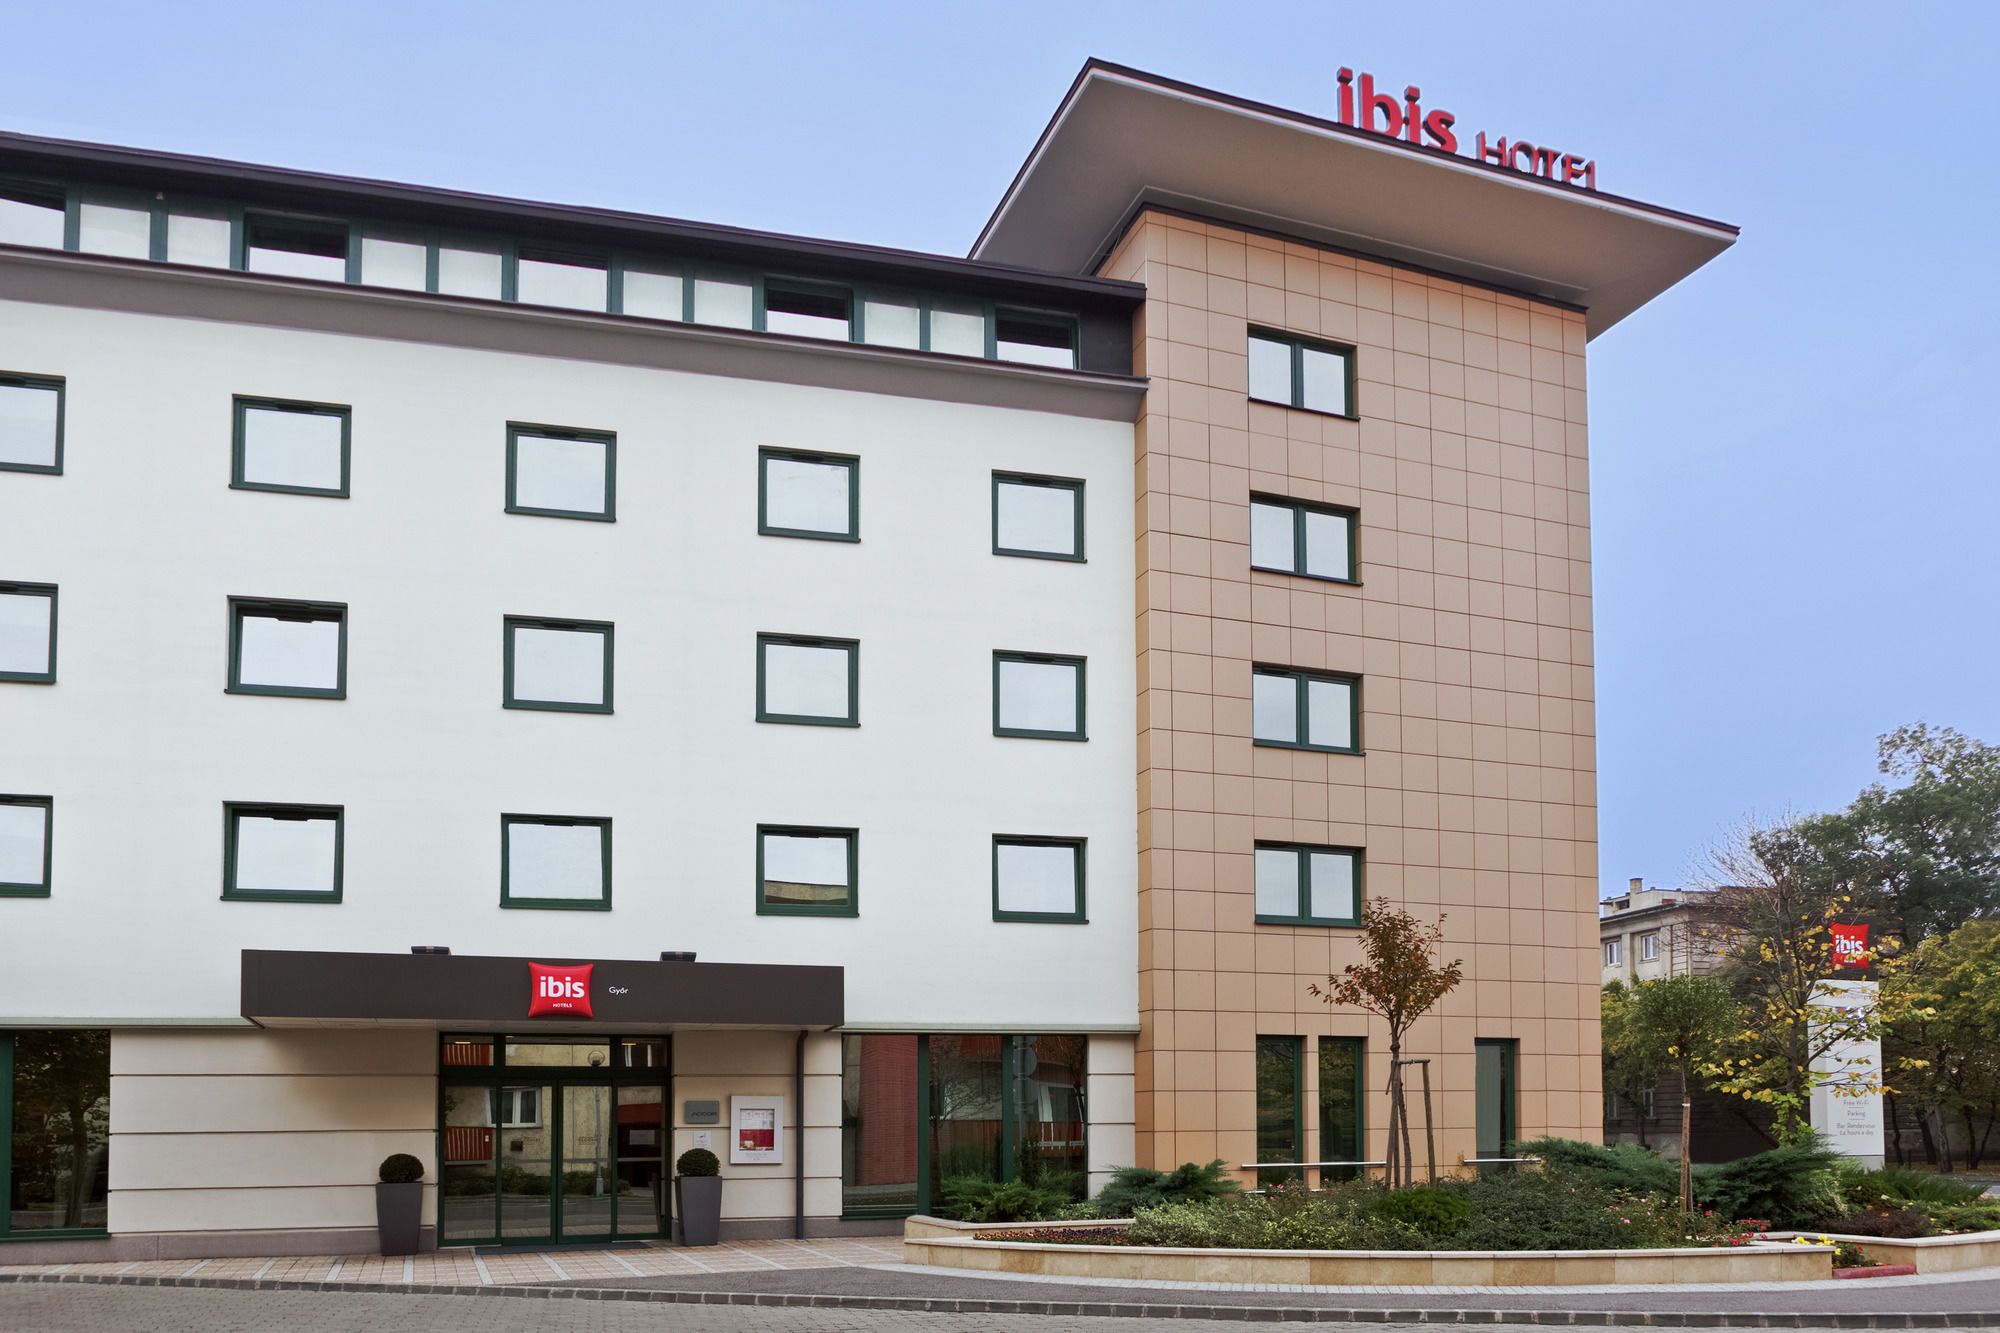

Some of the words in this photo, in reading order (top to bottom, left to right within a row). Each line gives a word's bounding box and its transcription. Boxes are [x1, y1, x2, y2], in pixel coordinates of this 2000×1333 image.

[1336, 66, 1458, 154] ibis
[1835, 934, 1864, 955] ibis
[540, 976, 585, 998] ibis
[1848, 1110, 1866, 1118] Parking
